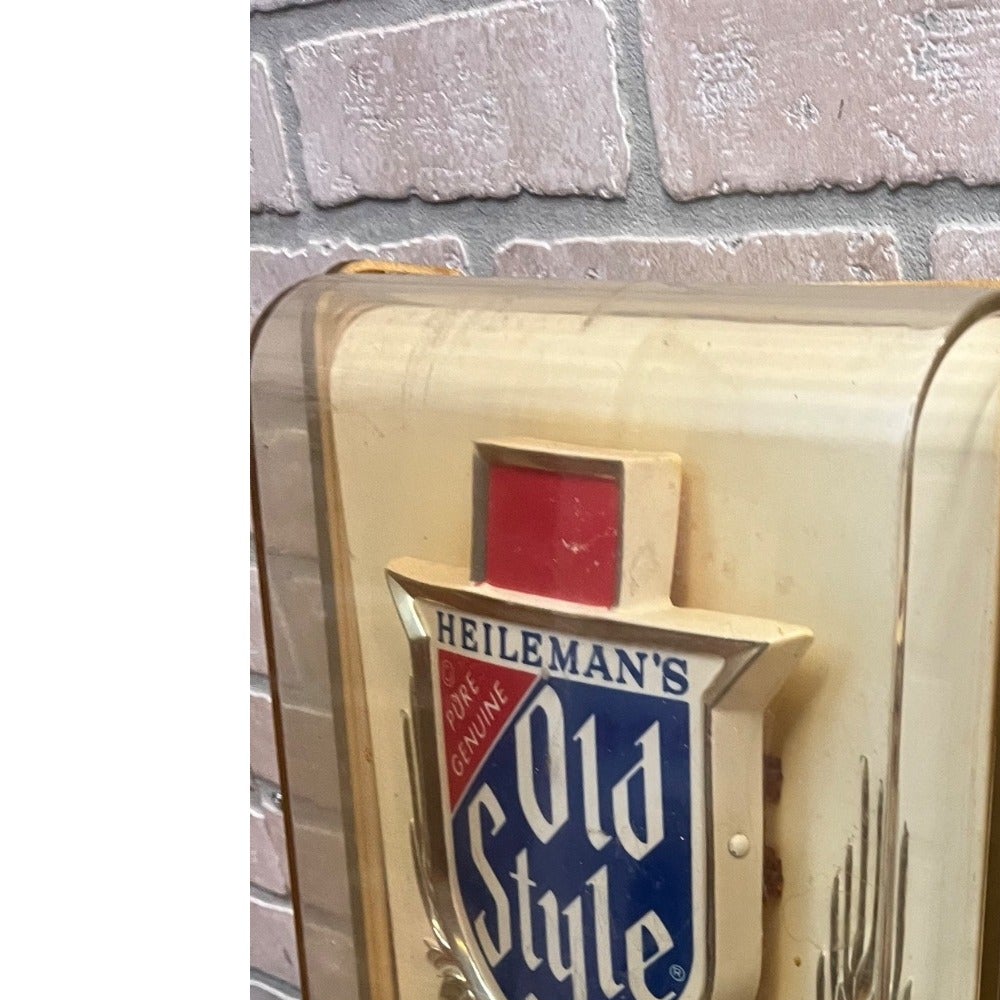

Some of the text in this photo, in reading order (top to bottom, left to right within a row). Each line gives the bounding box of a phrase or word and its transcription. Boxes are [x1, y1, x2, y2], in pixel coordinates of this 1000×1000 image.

[436, 611, 690, 695] HEILEMAN'S
[446, 671, 479, 731] PURE
[451, 680, 508, 776] GENUINE
[514, 684, 664, 861] Old
